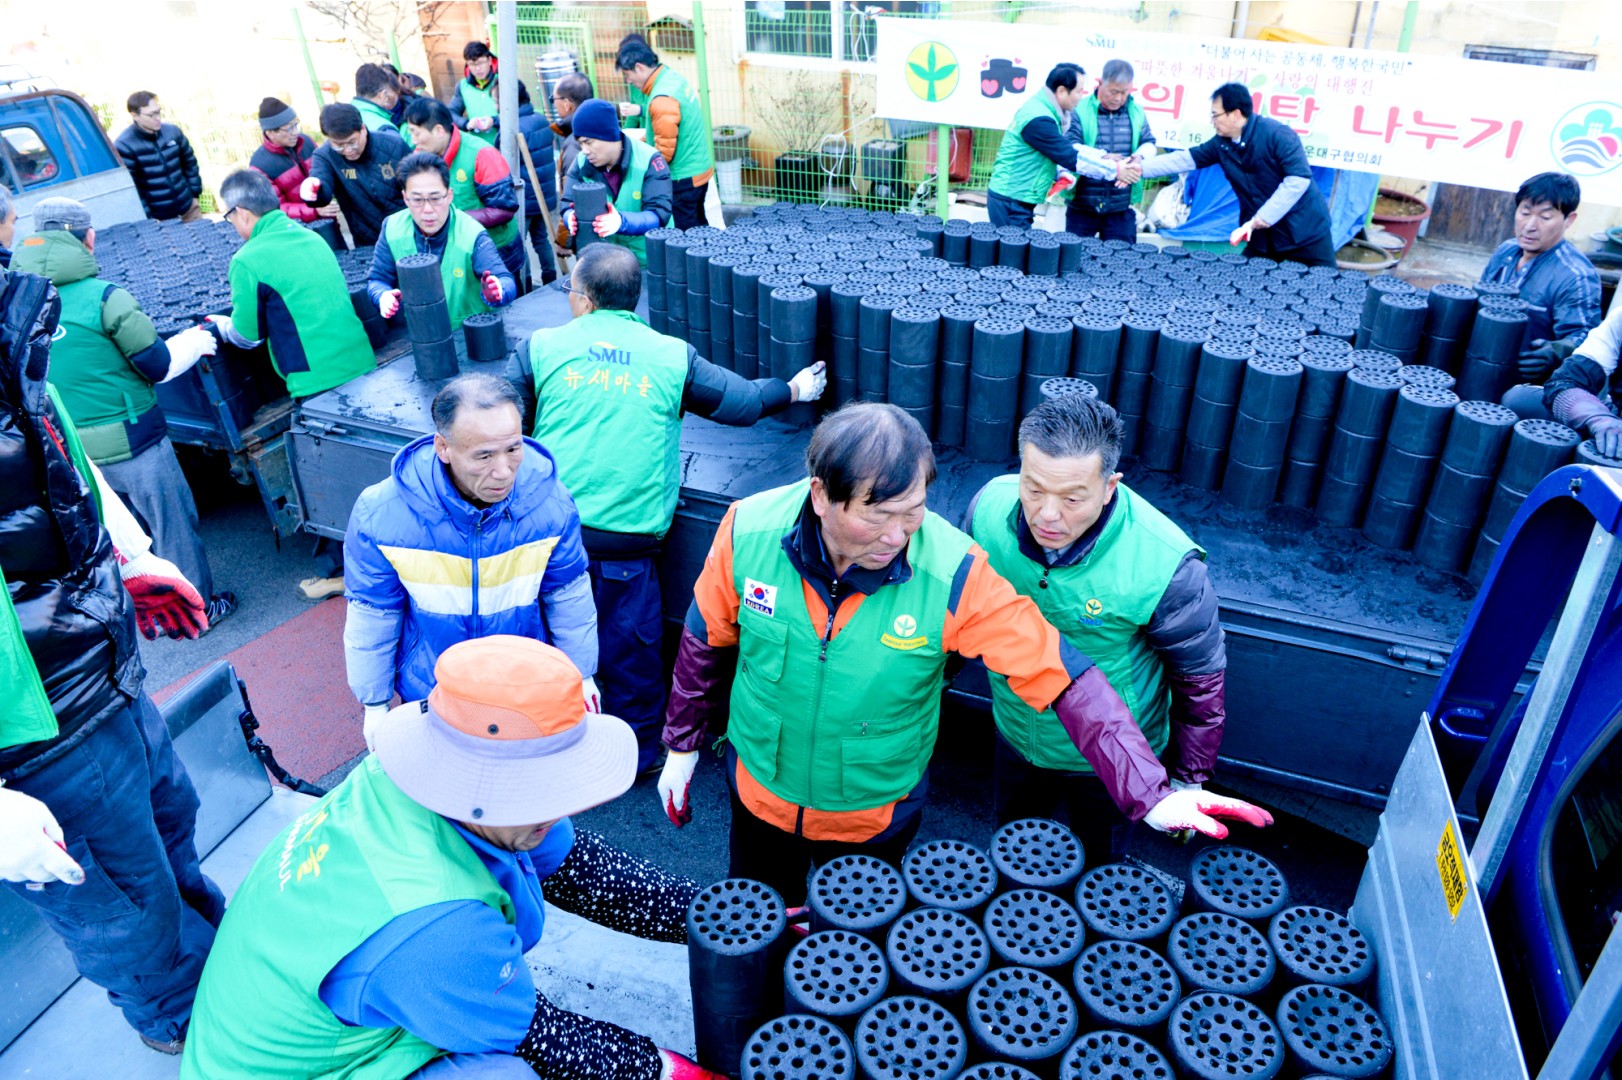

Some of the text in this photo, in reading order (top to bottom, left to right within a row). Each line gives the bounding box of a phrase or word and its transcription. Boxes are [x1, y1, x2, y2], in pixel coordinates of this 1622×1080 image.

[1086, 36, 1116, 49] SMU
[1250, 48, 1277, 64] 사는
[1273, 70, 1319, 91] 사랑의
[1326, 76, 1374, 97] 대행진
[1251, 91, 1524, 160] 탄 나누기
[1304, 145, 1382, 166] 운대구협의회
[587, 345, 632, 366] SMU
